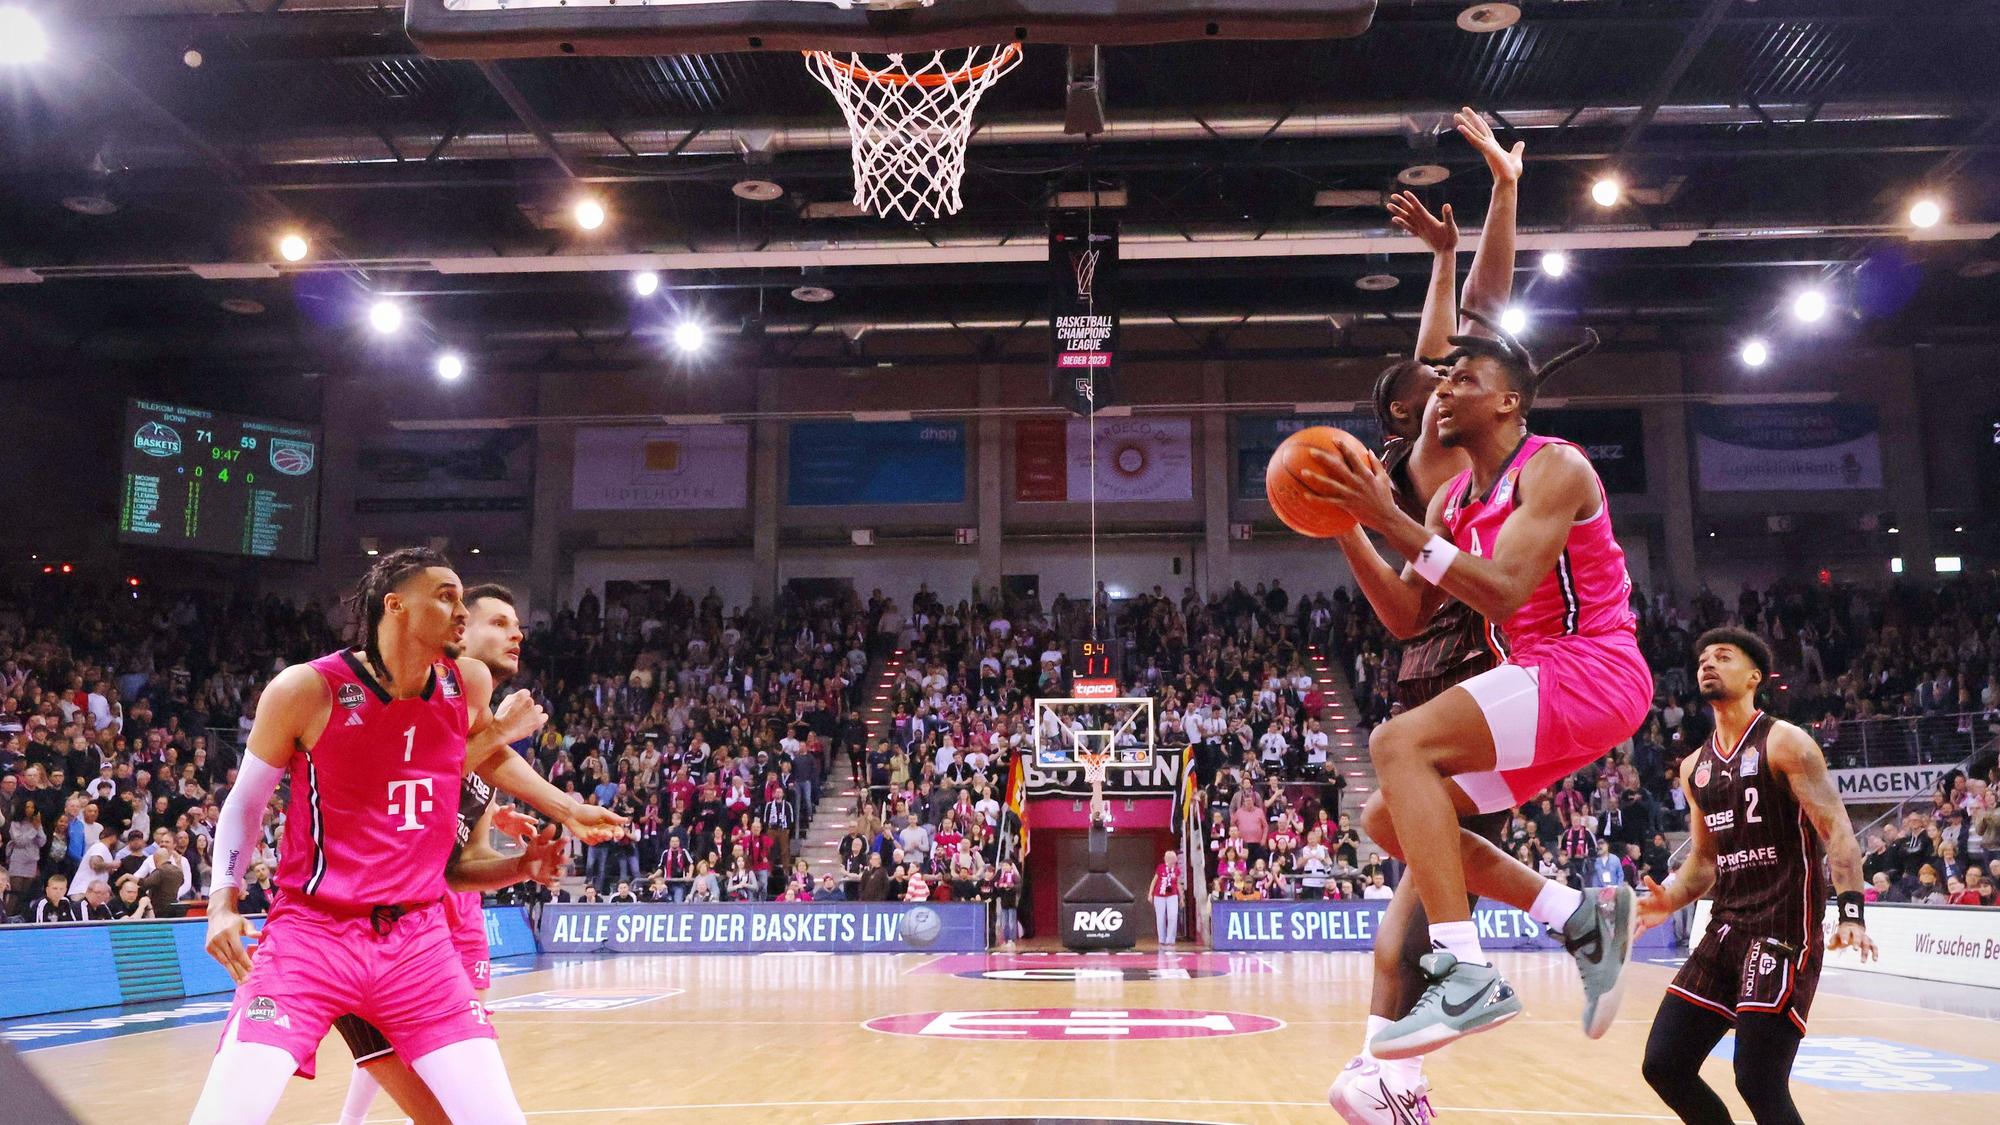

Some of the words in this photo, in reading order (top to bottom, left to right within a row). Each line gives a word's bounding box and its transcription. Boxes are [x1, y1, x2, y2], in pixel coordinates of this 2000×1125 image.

[1056, 316, 1112, 328] BASKETBALL
[1057, 327, 1111, 339] CHAMPIONS
[1067, 339, 1102, 351] LEAGUE
[1062, 355, 1087, 365] SIEGER
[1088, 355, 1107, 365] 2023
[136, 401, 174, 413] TELEKOM
[177, 407, 213, 419] BASKETS
[164, 414, 187, 424] BONN
[196, 430, 213, 443] 71
[920, 426, 958, 442] dhpg
[136, 436, 179, 451] BASKETS
[240, 436, 257, 449] 59
[211, 447, 240, 462] 9:47
[195, 466, 203, 477] 0
[218, 468, 230, 482] 4
[246, 473, 254, 484] 0
[1471, 527, 1482, 556] 4
[1083, 643, 1105, 656] 9.4
[1076, 683, 1114, 695] tipico
[403, 726, 416, 762] 1
[1745, 787, 1762, 823] 2
[1073, 908, 1123, 931] RKG
[1228, 911, 1284, 940] ALLE
[1290, 911, 1371, 940] SPIELE
[1472, 909, 1539, 938] KETS
[553, 914, 611, 943] ALLE
[615, 914, 694, 943] SPIELE
[700, 914, 745, 943] DER
[751, 913, 856, 942] BASKETS
[1915, 933, 1935, 953] Wir
[1937, 936, 1980, 958] suchen
